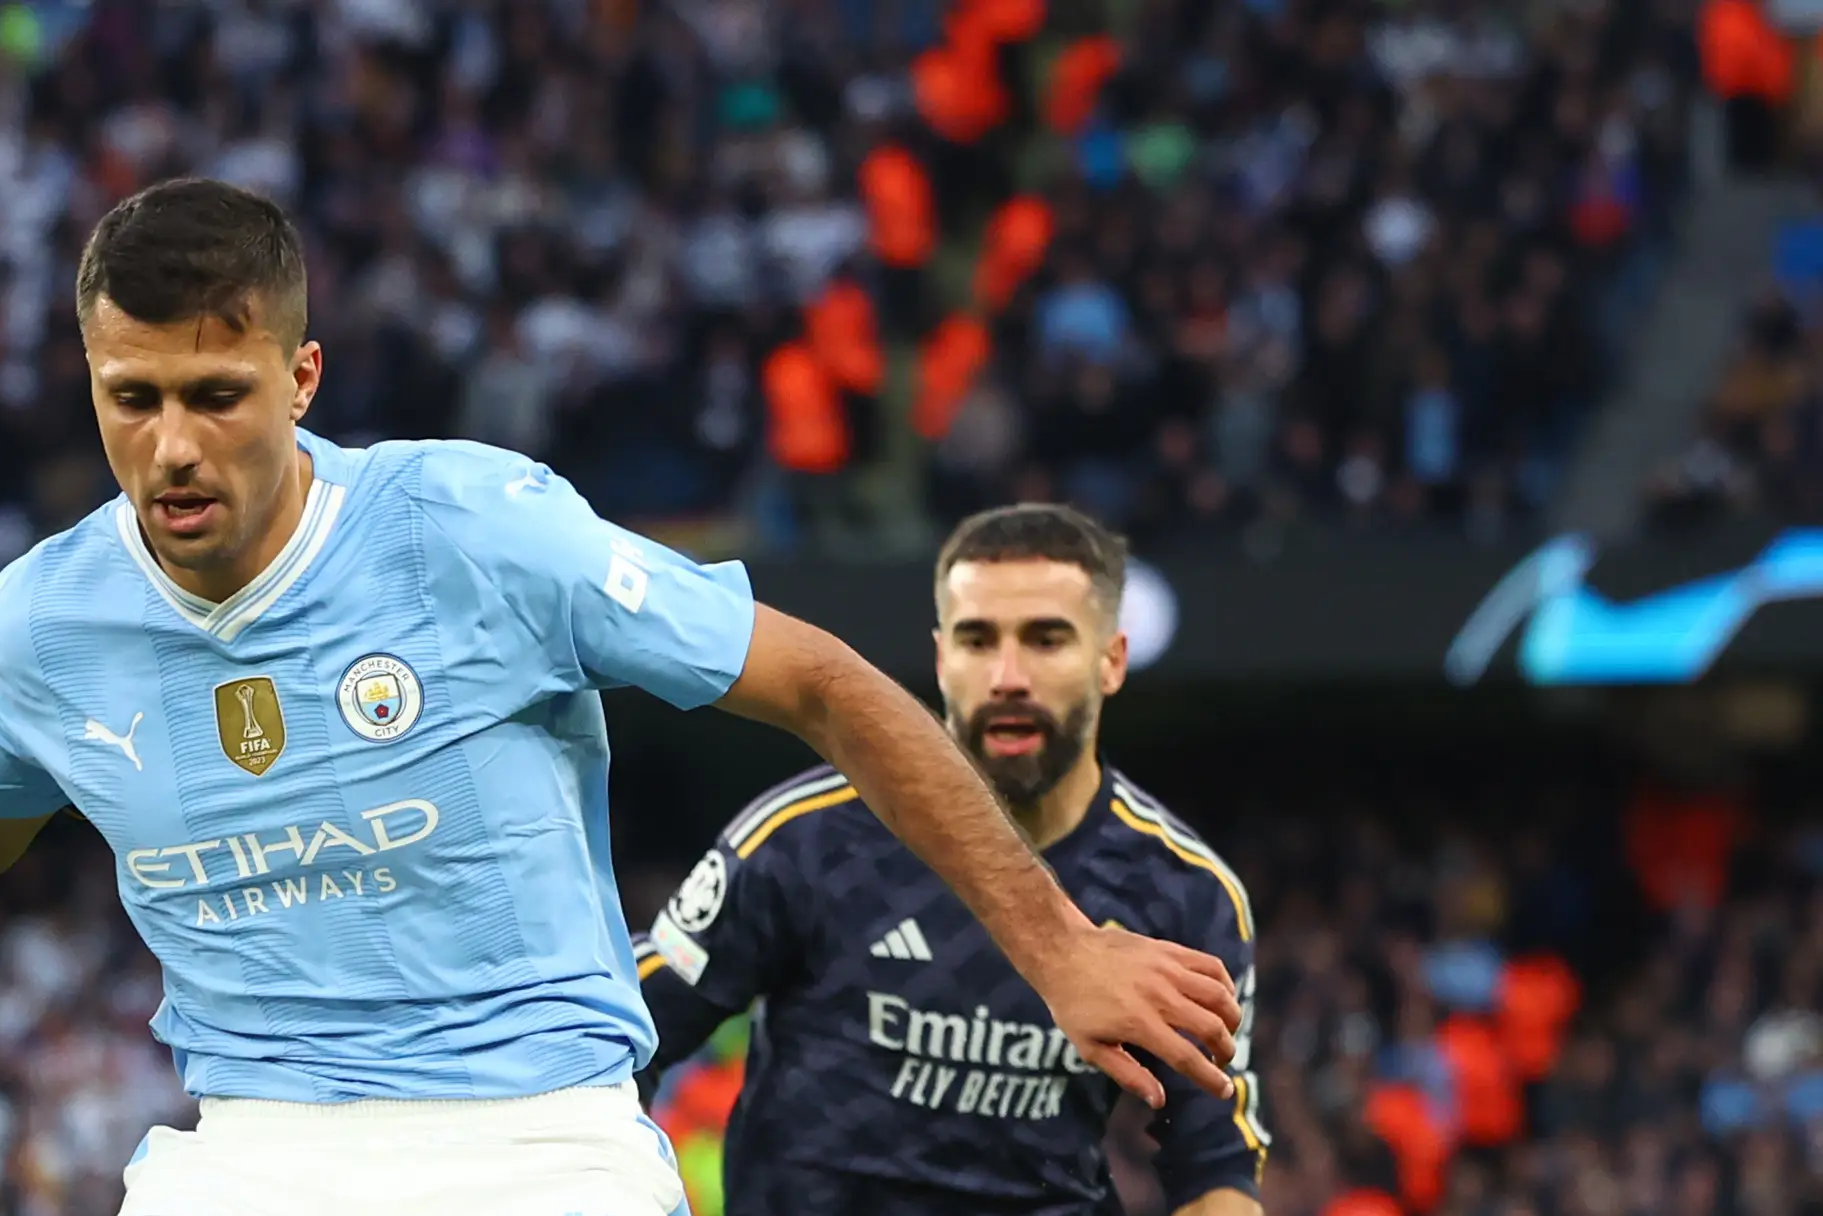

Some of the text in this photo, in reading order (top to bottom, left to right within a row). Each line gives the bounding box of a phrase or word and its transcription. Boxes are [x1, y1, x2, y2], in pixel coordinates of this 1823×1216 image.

[344, 660, 410, 692] MANCHESTER
[240, 738, 270, 753] FIFA
[375, 725, 399, 737] CITY
[126, 798, 439, 888] ETIHAD
[196, 867, 397, 926] AIRWAYS
[866, 990, 1098, 1074] Emirate
[889, 1057, 957, 1110] FLY
